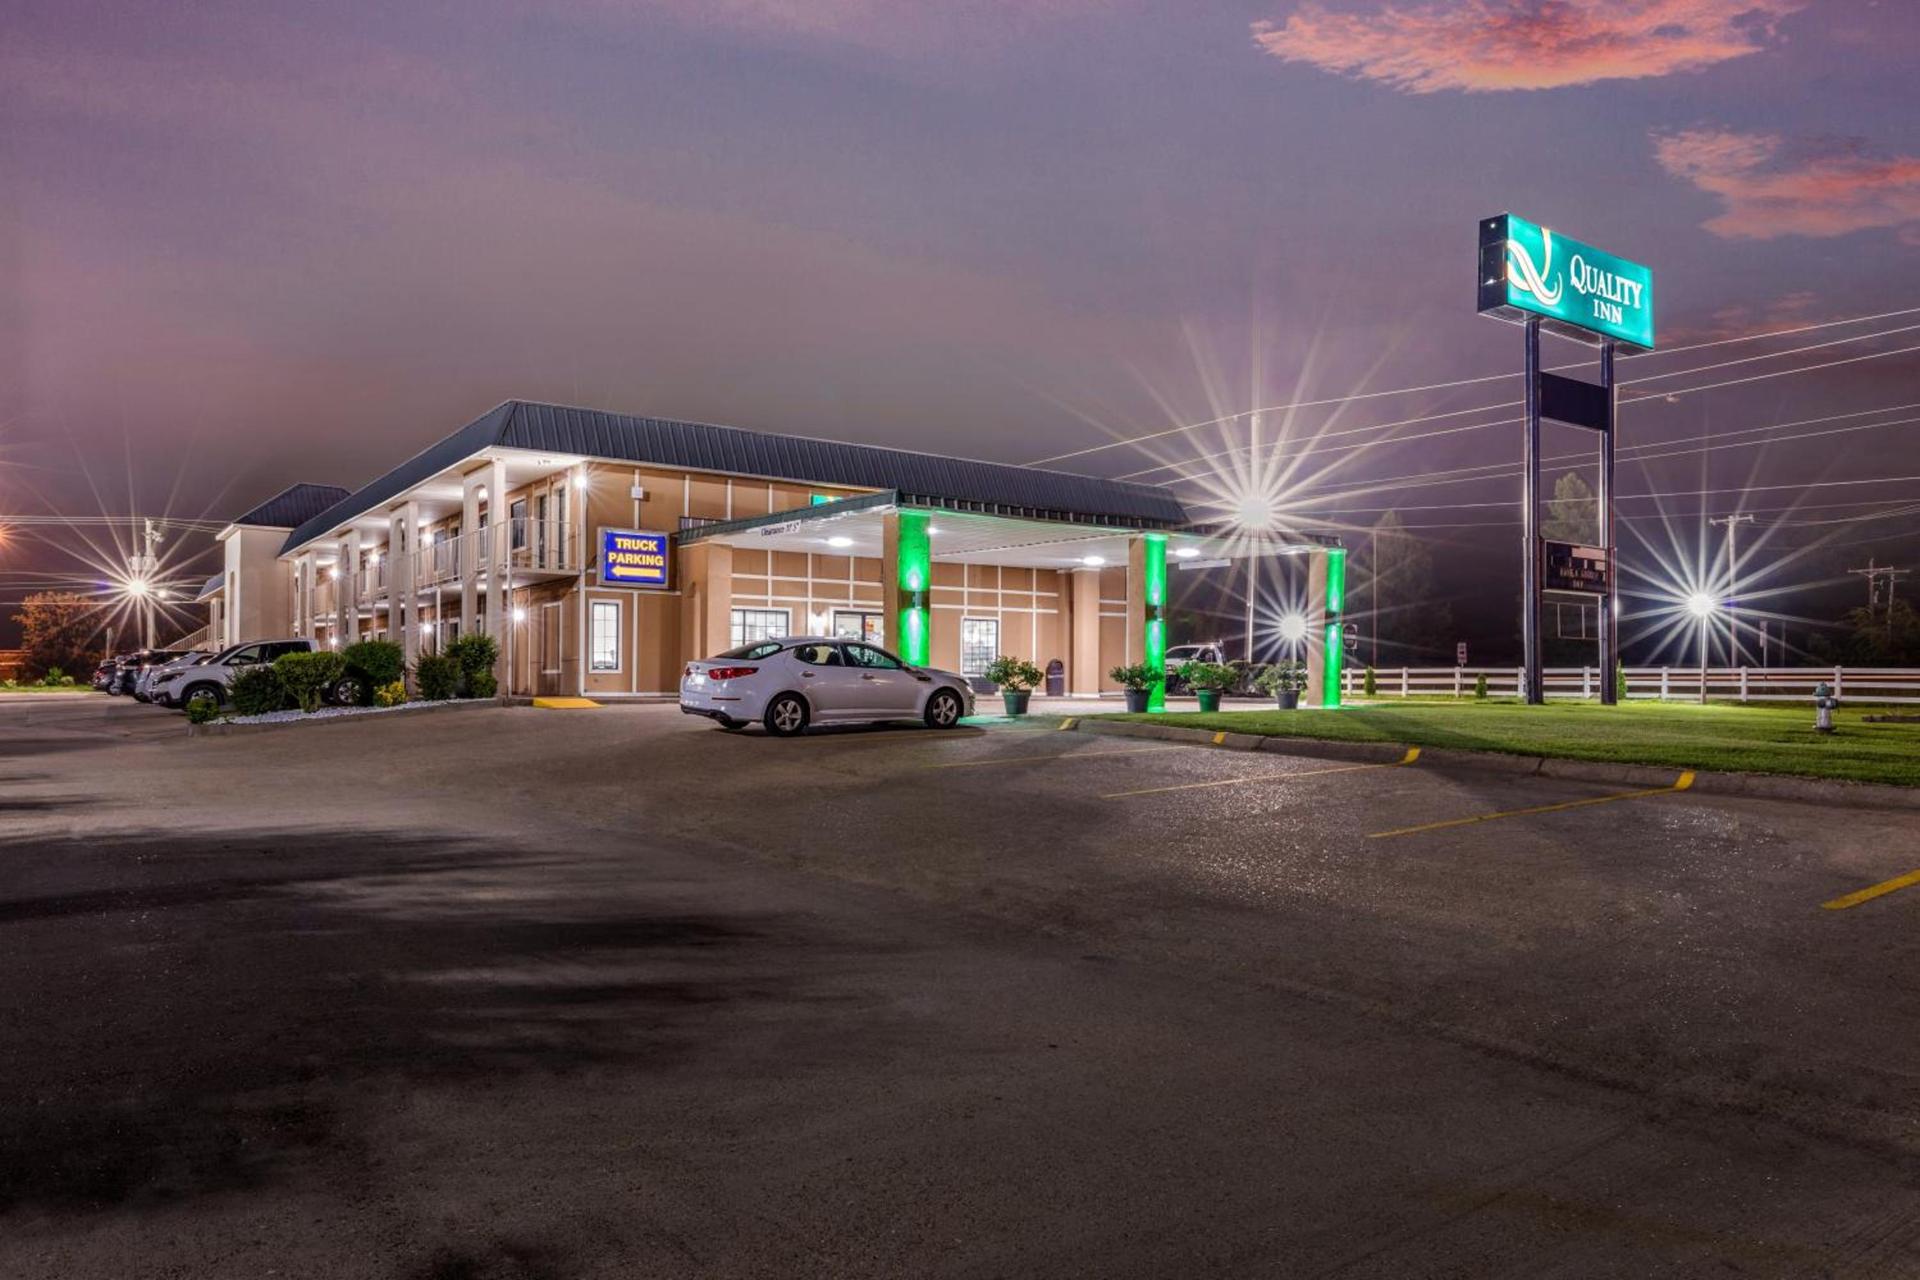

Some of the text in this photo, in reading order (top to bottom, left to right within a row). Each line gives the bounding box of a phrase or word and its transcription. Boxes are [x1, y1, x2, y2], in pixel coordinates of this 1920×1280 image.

[1570, 254, 1643, 309] QUALITY
[1593, 299, 1623, 325] INN
[615, 537, 658, 551] TRUCK
[608, 552, 664, 566] PARKING
